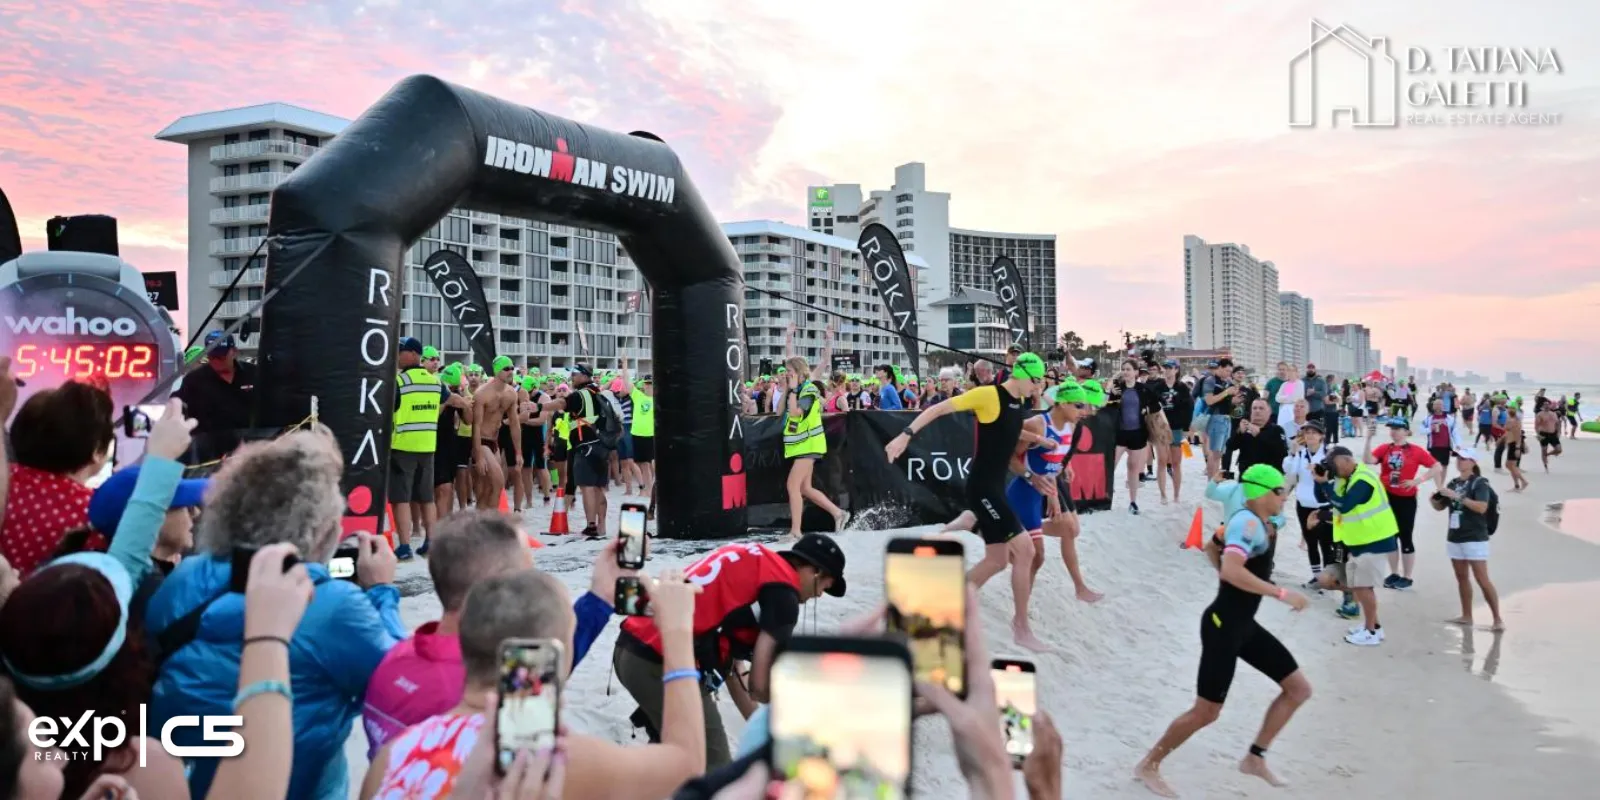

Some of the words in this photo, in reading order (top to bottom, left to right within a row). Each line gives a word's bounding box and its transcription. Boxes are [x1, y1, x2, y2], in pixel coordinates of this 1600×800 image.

[484, 135, 608, 190] IRONMAN
[611, 165, 675, 204] SWIM
[4, 307, 137, 336] wahoo
